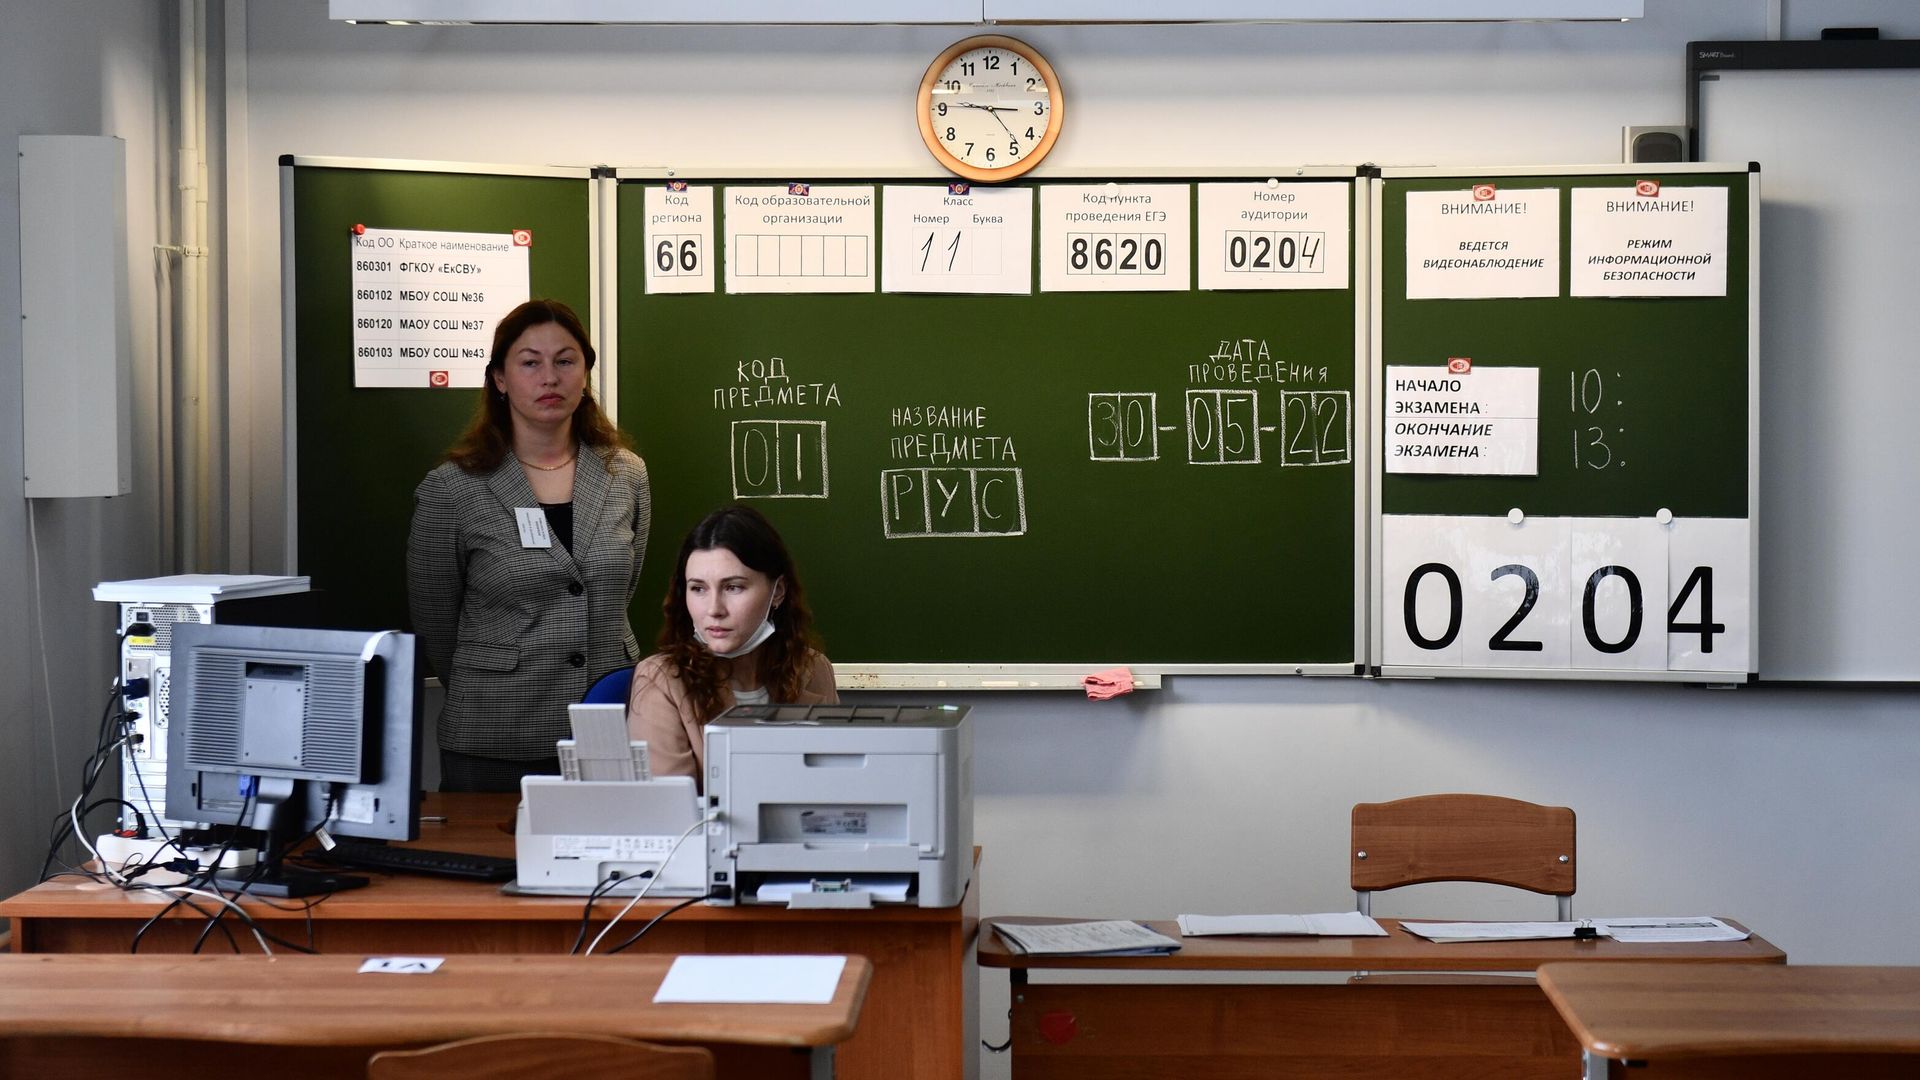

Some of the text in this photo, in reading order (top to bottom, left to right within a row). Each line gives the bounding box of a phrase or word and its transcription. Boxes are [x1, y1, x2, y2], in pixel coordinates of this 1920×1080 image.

[961, 62, 974, 76] 11
[983, 56, 999, 70] 12
[1011, 62, 1016, 75] 1
[944, 80, 960, 94] 10
[1026, 78, 1036, 92] 2
[938, 103, 947, 116] 9
[1034, 102, 1043, 115] 3
[946, 127, 955, 140] 8
[1025, 127, 1034, 140] 4
[965, 143, 974, 156] 7
[986, 148, 995, 161] 6
[1010, 142, 1018, 155] 5
[665, 196, 689, 206] Код
[735, 196, 871, 207] Код образовательной
[943, 197, 973, 206] Класс
[1083, 194, 1106, 205] Код
[1254, 191, 1295, 203] Номер
[1441, 202, 1526, 215] ВНИМАНИЕ!
[1607, 201, 1694, 213] ВНИМАНИЕ!
[652, 214, 702, 225] региона
[763, 215, 842, 225] организации
[913, 214, 1003, 225] Номер Буква
[1065, 211, 1166, 223] проведения ЕГЭ
[1241, 210, 1308, 221] аудитории
[356, 237, 509, 252] Код ОО Краткое наименование
[1459, 241, 1508, 252] ВЕДЕТСЯ
[1627, 239, 1672, 249] РЕЖИМ
[656, 240, 697, 272] 66
[1071, 238, 1162, 271] 8620
[1230, 236, 1320, 268] 0204
[1423, 258, 1544, 270] ВИДЕОНАБЛЮДЕНИЕ
[1588, 253, 1711, 266] ИНФОРМАЦИОННОЙ
[357, 261, 481, 274] 860301 ФГКОУ «ЕкСВУ»
[1603, 271, 1695, 281] БЕЗОПАСНОСТИ
[357, 290, 484, 302] 860102 МБОУ СОШ №36
[358, 319, 484, 330] 860120 МАОУ СОШ №37
[358, 347, 484, 358] 860103 МБОУ СОШ №43
[1209, 339, 1271, 363] ДАТА
[738, 357, 789, 384] КОД
[1189, 360, 1328, 384] ПРОВЕДЕНИЯ
[1396, 379, 1461, 392] НАЧАЛО
[714, 383, 841, 410] ПРЕДМЕТА
[892, 405, 986, 429] НАЗВАНИЕ
[1395, 423, 1493, 436] ОКОНЧАНИЕ
[891, 433, 1017, 464] ПРЕДМЕТА
[893, 474, 1003, 521] РУС
[1404, 562, 1725, 653] 0204
